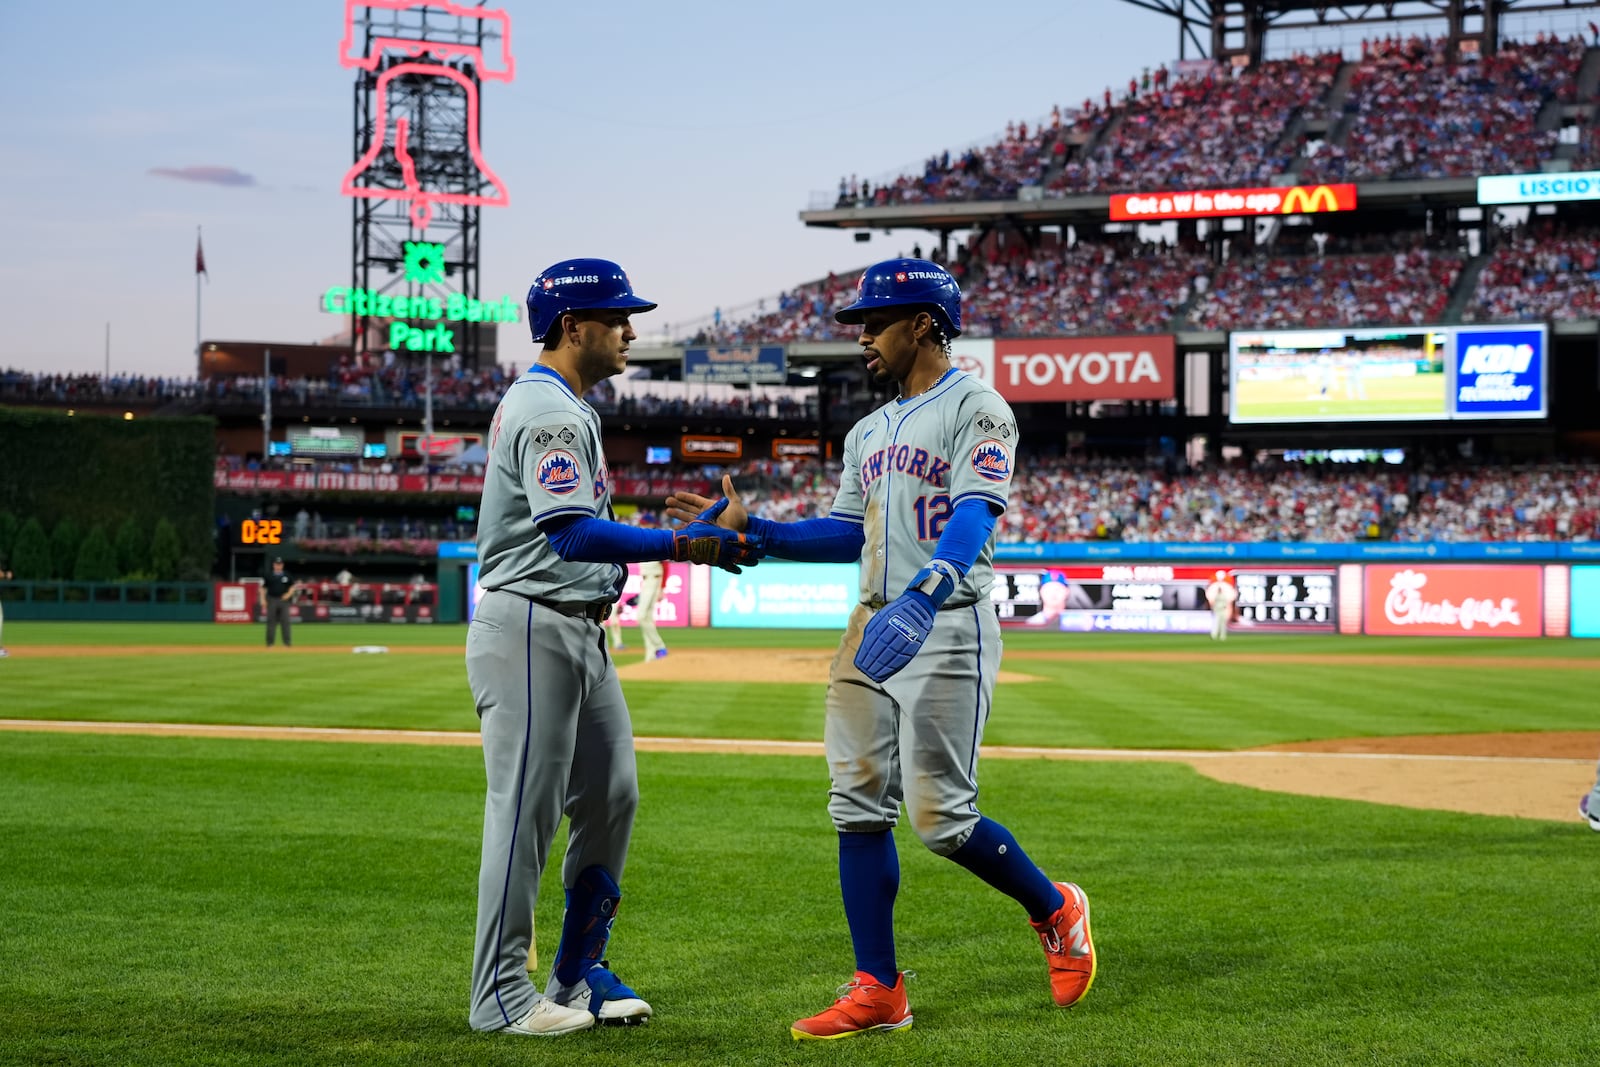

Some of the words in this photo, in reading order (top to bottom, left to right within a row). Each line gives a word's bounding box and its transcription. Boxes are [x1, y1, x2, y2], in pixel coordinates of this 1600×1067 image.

[1126, 197, 1158, 214] Get
[1173, 195, 1192, 211] W
[1194, 193, 1212, 211] in
[1215, 193, 1244, 210] the
[1246, 194, 1281, 211] app
[554, 275, 599, 286] STRAUSS
[908, 271, 948, 281] STRAUSS
[324, 285, 443, 320] Citizens
[446, 291, 520, 323] Bank
[389, 320, 455, 353] Park
[1001, 351, 1162, 386] TOYOTA
[545, 466, 575, 484] Mets
[886, 443, 951, 488] YORK
[241, 519, 282, 544] 0:22
[913, 493, 951, 541] 12
